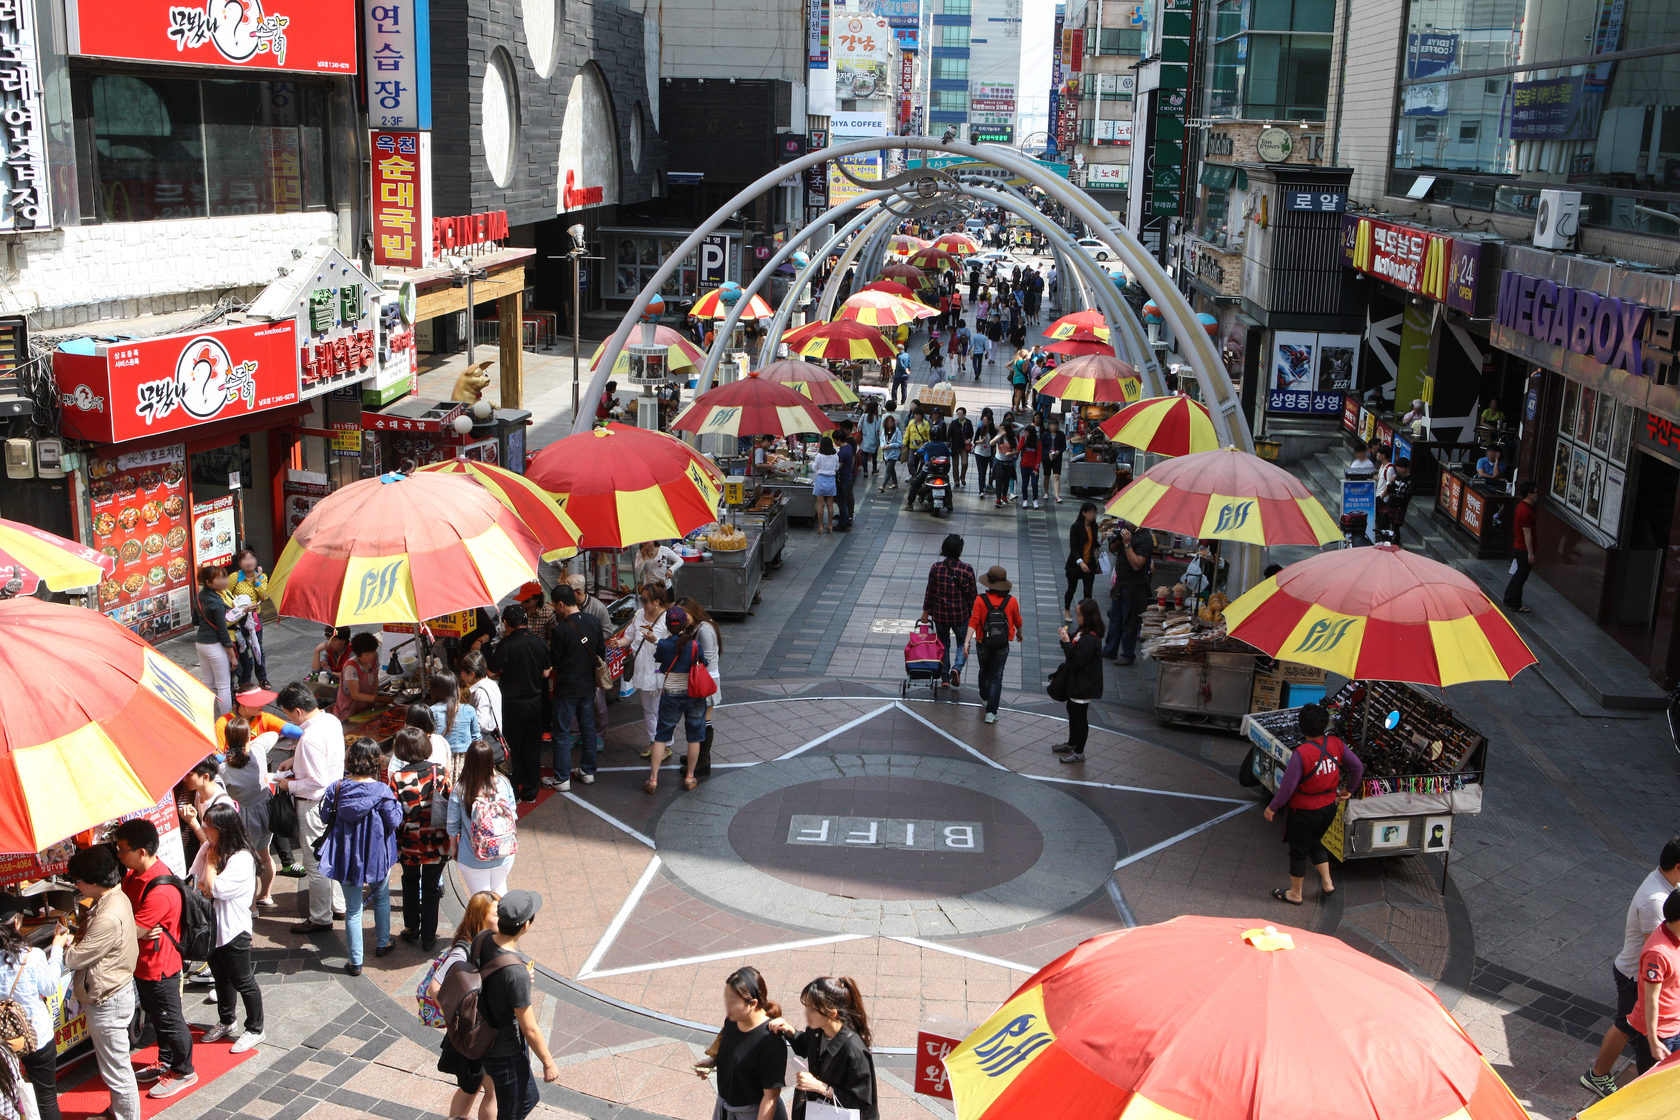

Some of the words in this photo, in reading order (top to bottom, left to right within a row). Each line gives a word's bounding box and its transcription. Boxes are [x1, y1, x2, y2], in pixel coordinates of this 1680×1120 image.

[838, 34, 876, 52] 강남
[370, 4, 408, 110] 연습장
[375, 135, 417, 154] 옥천
[378, 154, 416, 260] 순대국밥
[1293, 193, 1339, 211] 로얄
[1346, 224, 1356, 248] 24
[1374, 227, 1424, 263] 맥도날드
[702, 244, 724, 281] P
[1459, 254, 1475, 285] 24
[1458, 285, 1473, 301] OPEN
[1496, 270, 1650, 376] MEGABOX
[301, 330, 375, 384] 노래연습장
[1271, 393, 1310, 408] 상영중
[1313, 395, 1343, 411] 상영
[375, 420, 426, 430] 순대국밥
[149, 446, 183, 461] 호프치킨
[797, 820, 975, 848] BIFF
